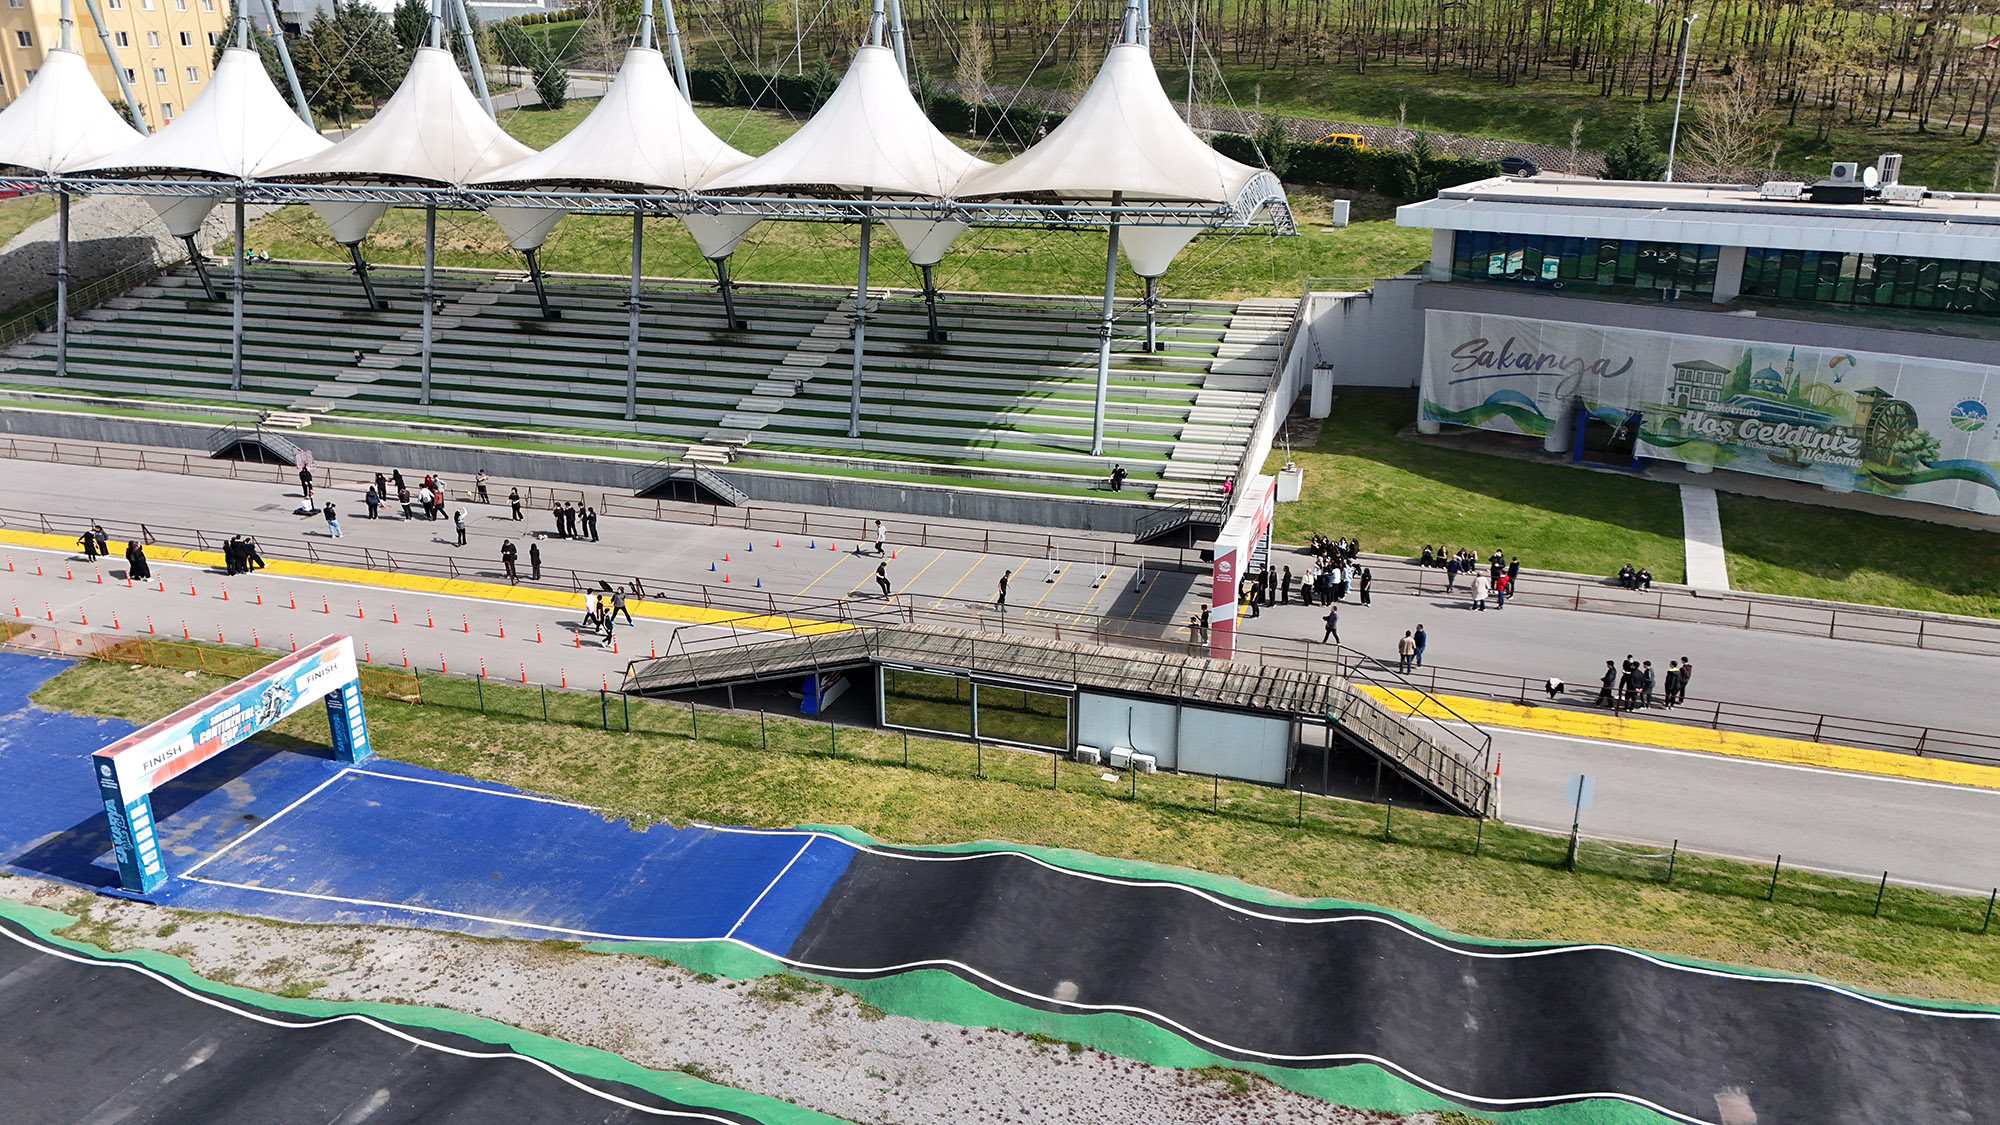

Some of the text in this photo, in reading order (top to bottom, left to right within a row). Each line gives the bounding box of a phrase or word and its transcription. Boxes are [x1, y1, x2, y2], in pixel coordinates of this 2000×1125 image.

[1450, 337, 1634, 401] Sakarya
[1705, 402, 1761, 417] Benvenuto
[1680, 409, 1860, 454] Hoş Geldiniz
[1800, 446, 1863, 468] Welcome
[306, 663, 338, 685] FINISH
[142, 745, 183, 771] FINISH
[105, 799, 128, 864] SAKARYA
